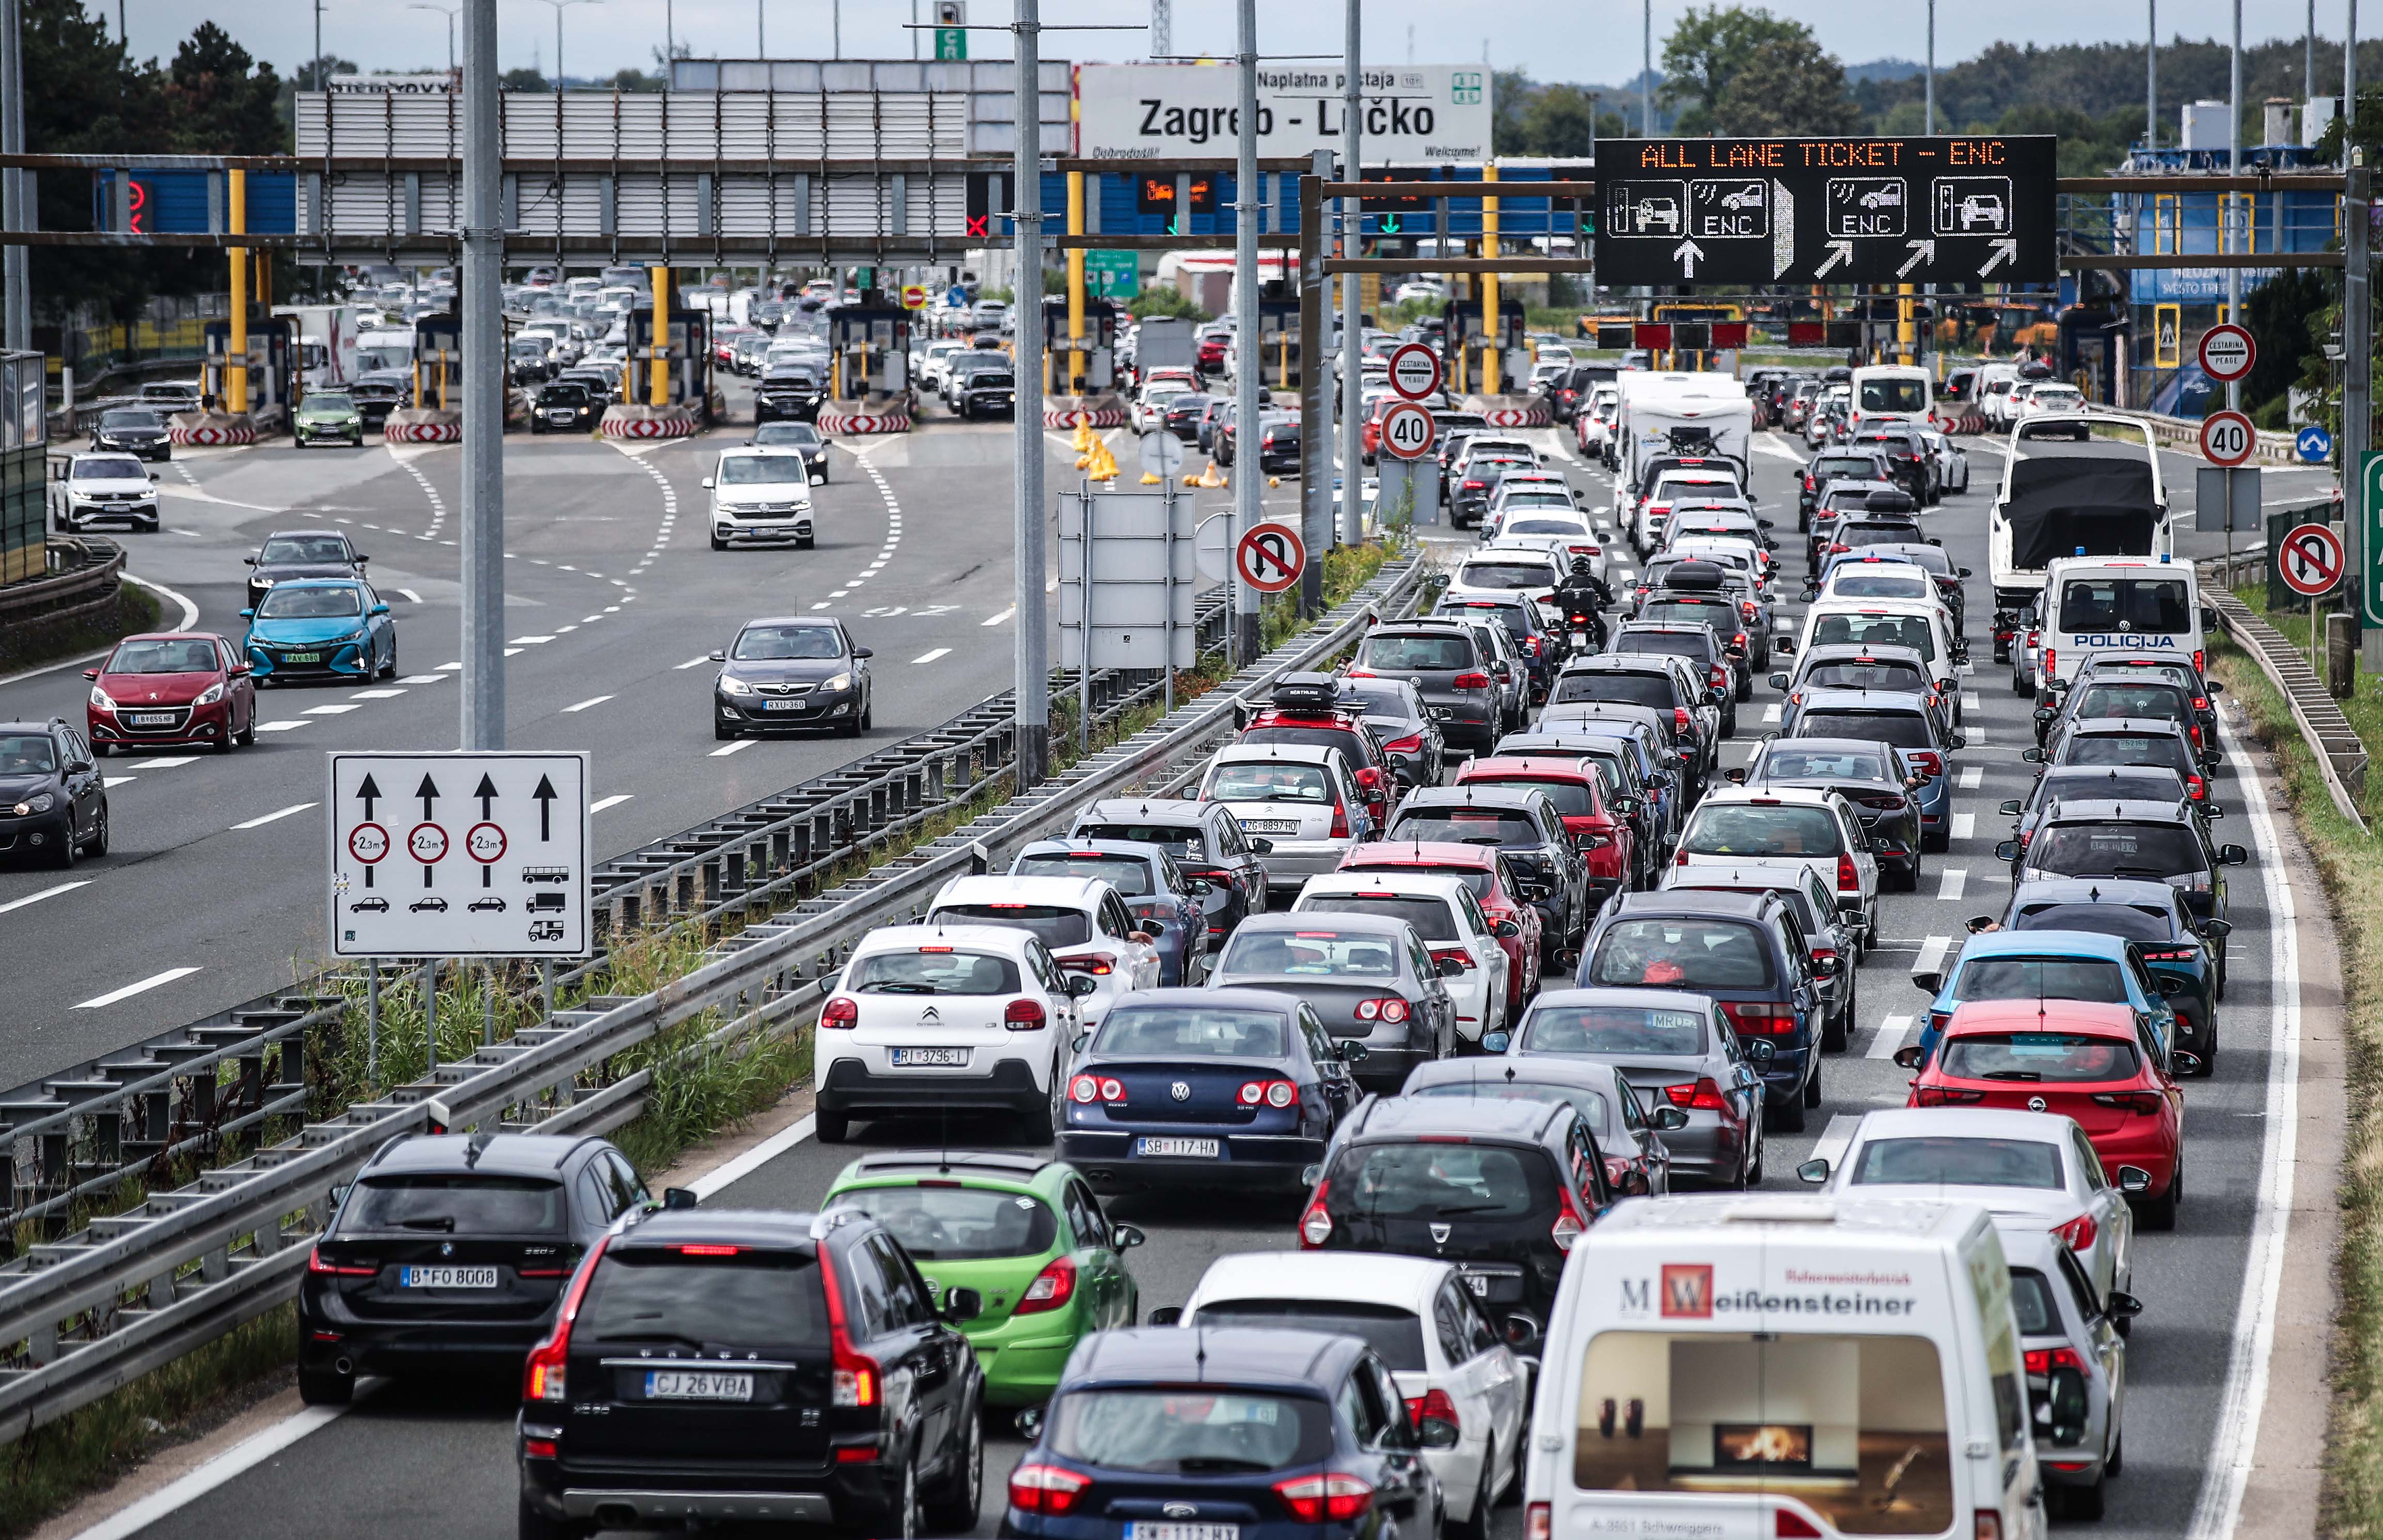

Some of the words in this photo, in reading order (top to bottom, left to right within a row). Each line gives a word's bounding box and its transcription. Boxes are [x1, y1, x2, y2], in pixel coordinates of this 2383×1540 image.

[1257, 71, 1328, 89] Naplatna
[1335, 71, 1394, 90] pstaja
[1318, 98, 1434, 135] Lčko
[1642, 145, 1696, 168] ALL
[1711, 144, 1785, 167] LANE
[1799, 143, 1904, 167] TICKET
[1950, 142, 2005, 165] ENC
[1704, 215, 1752, 234] ENC
[1842, 215, 1891, 234] ENC
[2210, 341, 2244, 350] CESTARINA
[1399, 360, 1430, 368] CESTARINA
[1395, 418, 1423, 443] 40
[2212, 427, 2244, 452] 40
[2074, 635, 2175, 648] POLICIJA
[768, 701, 804, 709] RXU-360
[1247, 821, 1257, 830] ZG
[901, 1050, 913, 1062] RI
[1147, 1140, 1162, 1153] SB
[411, 1269, 421, 1284] B
[432, 1269, 451, 1284] FO
[456, 1269, 494, 1284] 8008
[1621, 1279, 1650, 1311] M
[657, 1375, 680, 1393] CJ
[686, 1376, 707, 1394] 26
[713, 1376, 747, 1395] VBA
